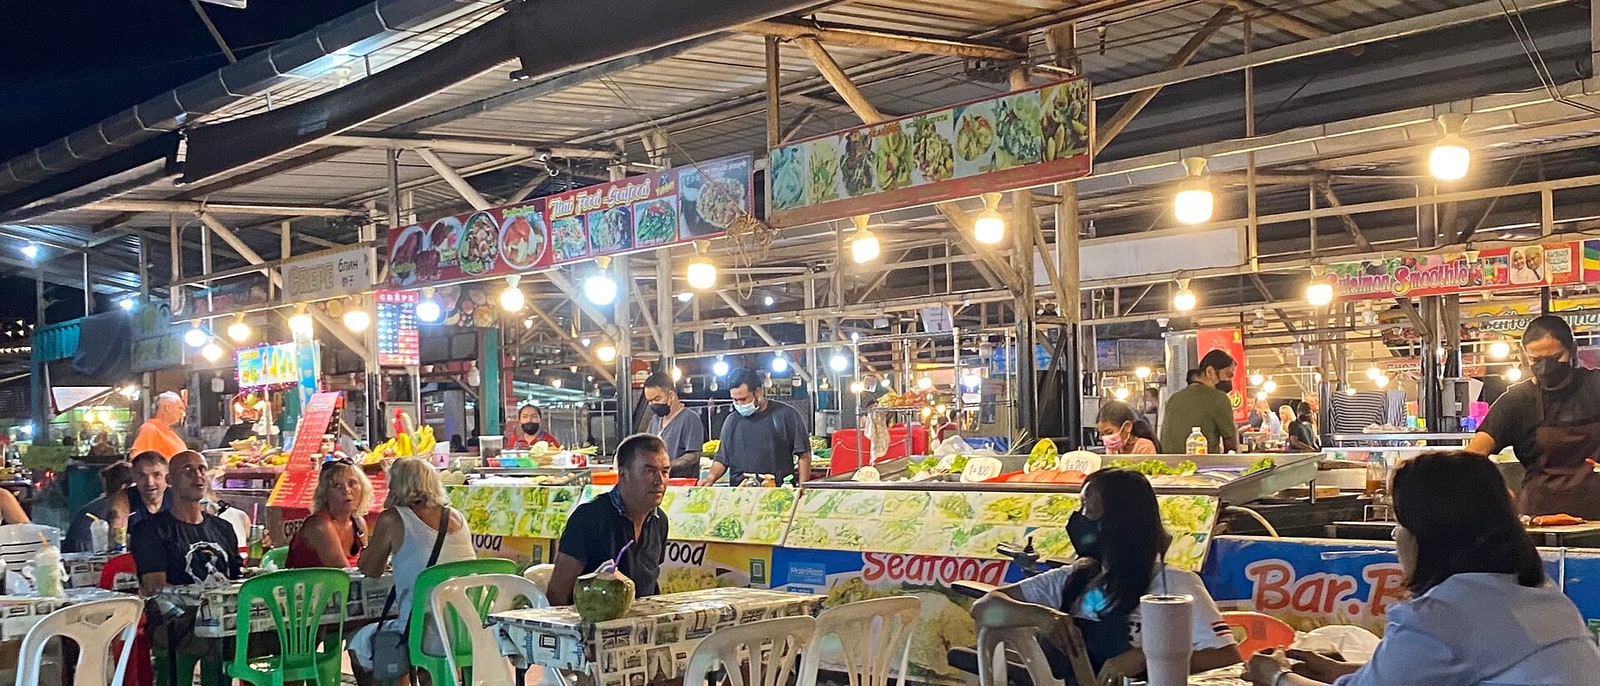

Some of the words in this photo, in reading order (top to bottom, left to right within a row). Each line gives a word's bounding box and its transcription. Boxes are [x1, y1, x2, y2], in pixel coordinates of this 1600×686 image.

[549, 196, 574, 220] Thai
[576, 189, 602, 214] Food
[1393, 263, 1469, 296] Smoothie
[863, 551, 1006, 587] Seafood
